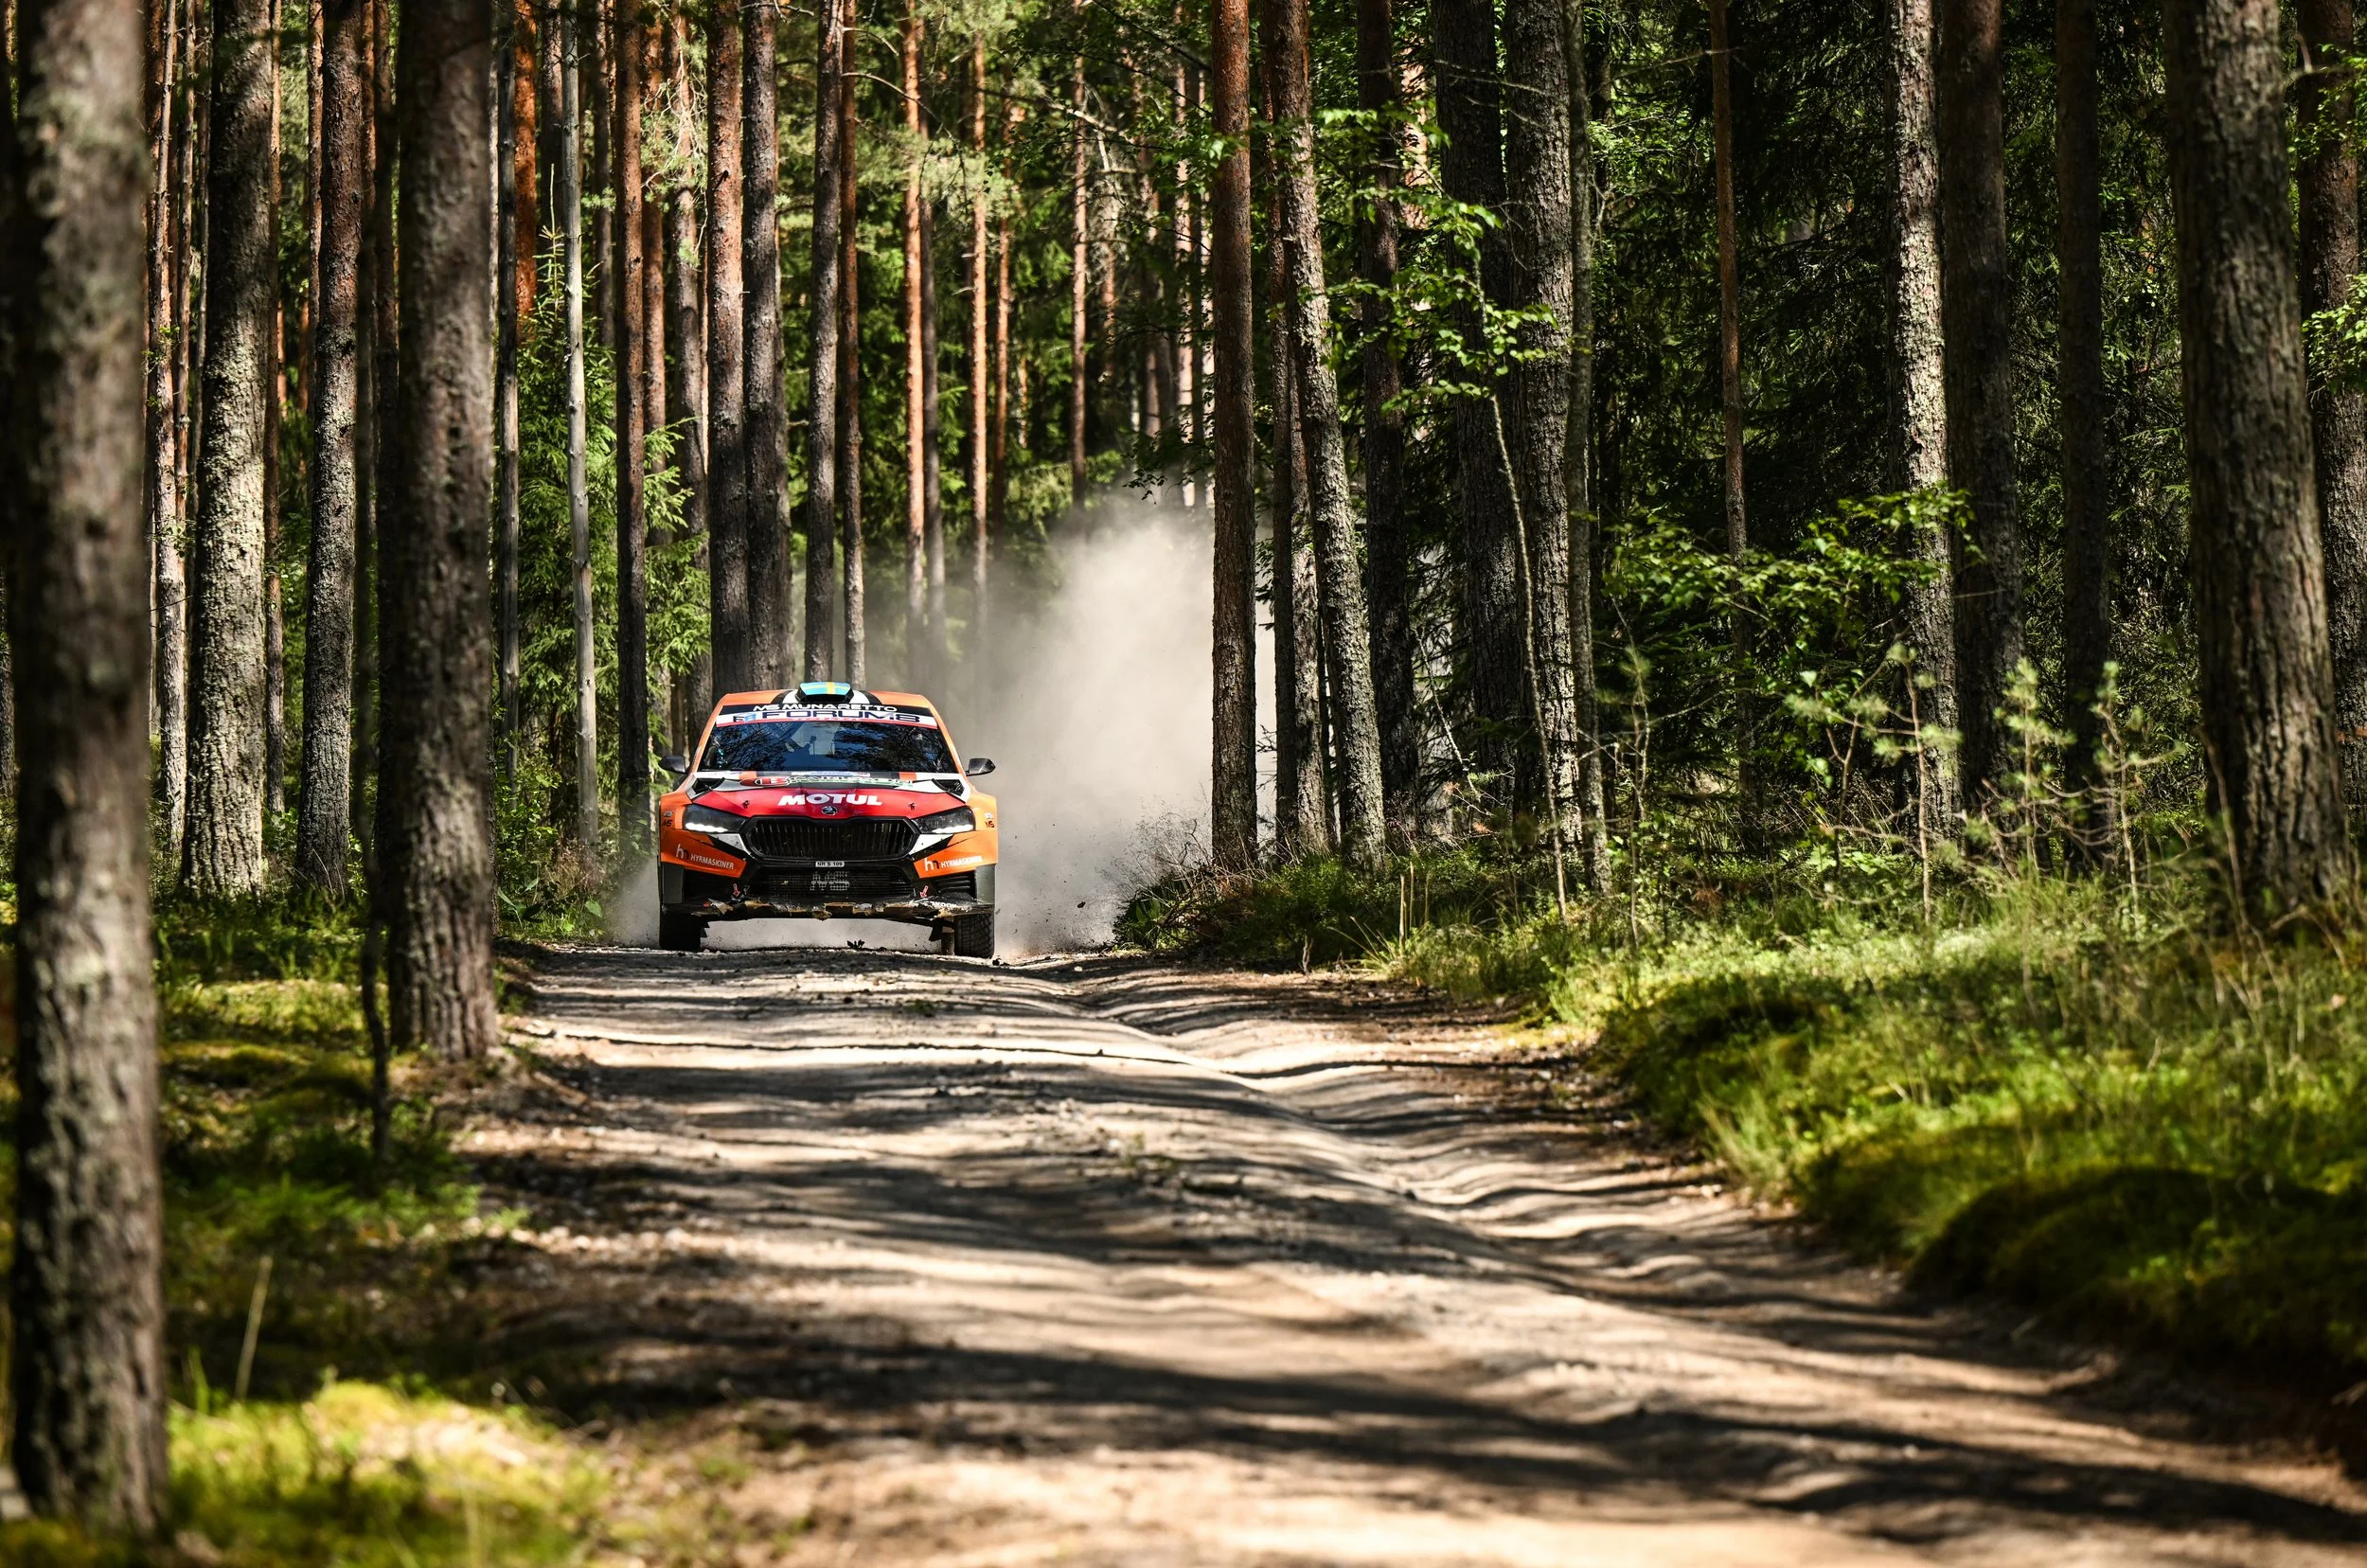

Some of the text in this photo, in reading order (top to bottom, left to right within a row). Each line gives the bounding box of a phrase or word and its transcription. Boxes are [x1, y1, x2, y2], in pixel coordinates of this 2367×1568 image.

[753, 703, 898, 712] MS MUNARETTO
[762, 710, 919, 722] FORUM8
[777, 793, 884, 806] MOTUL
[690, 853, 735, 870] HYRMASKINER
